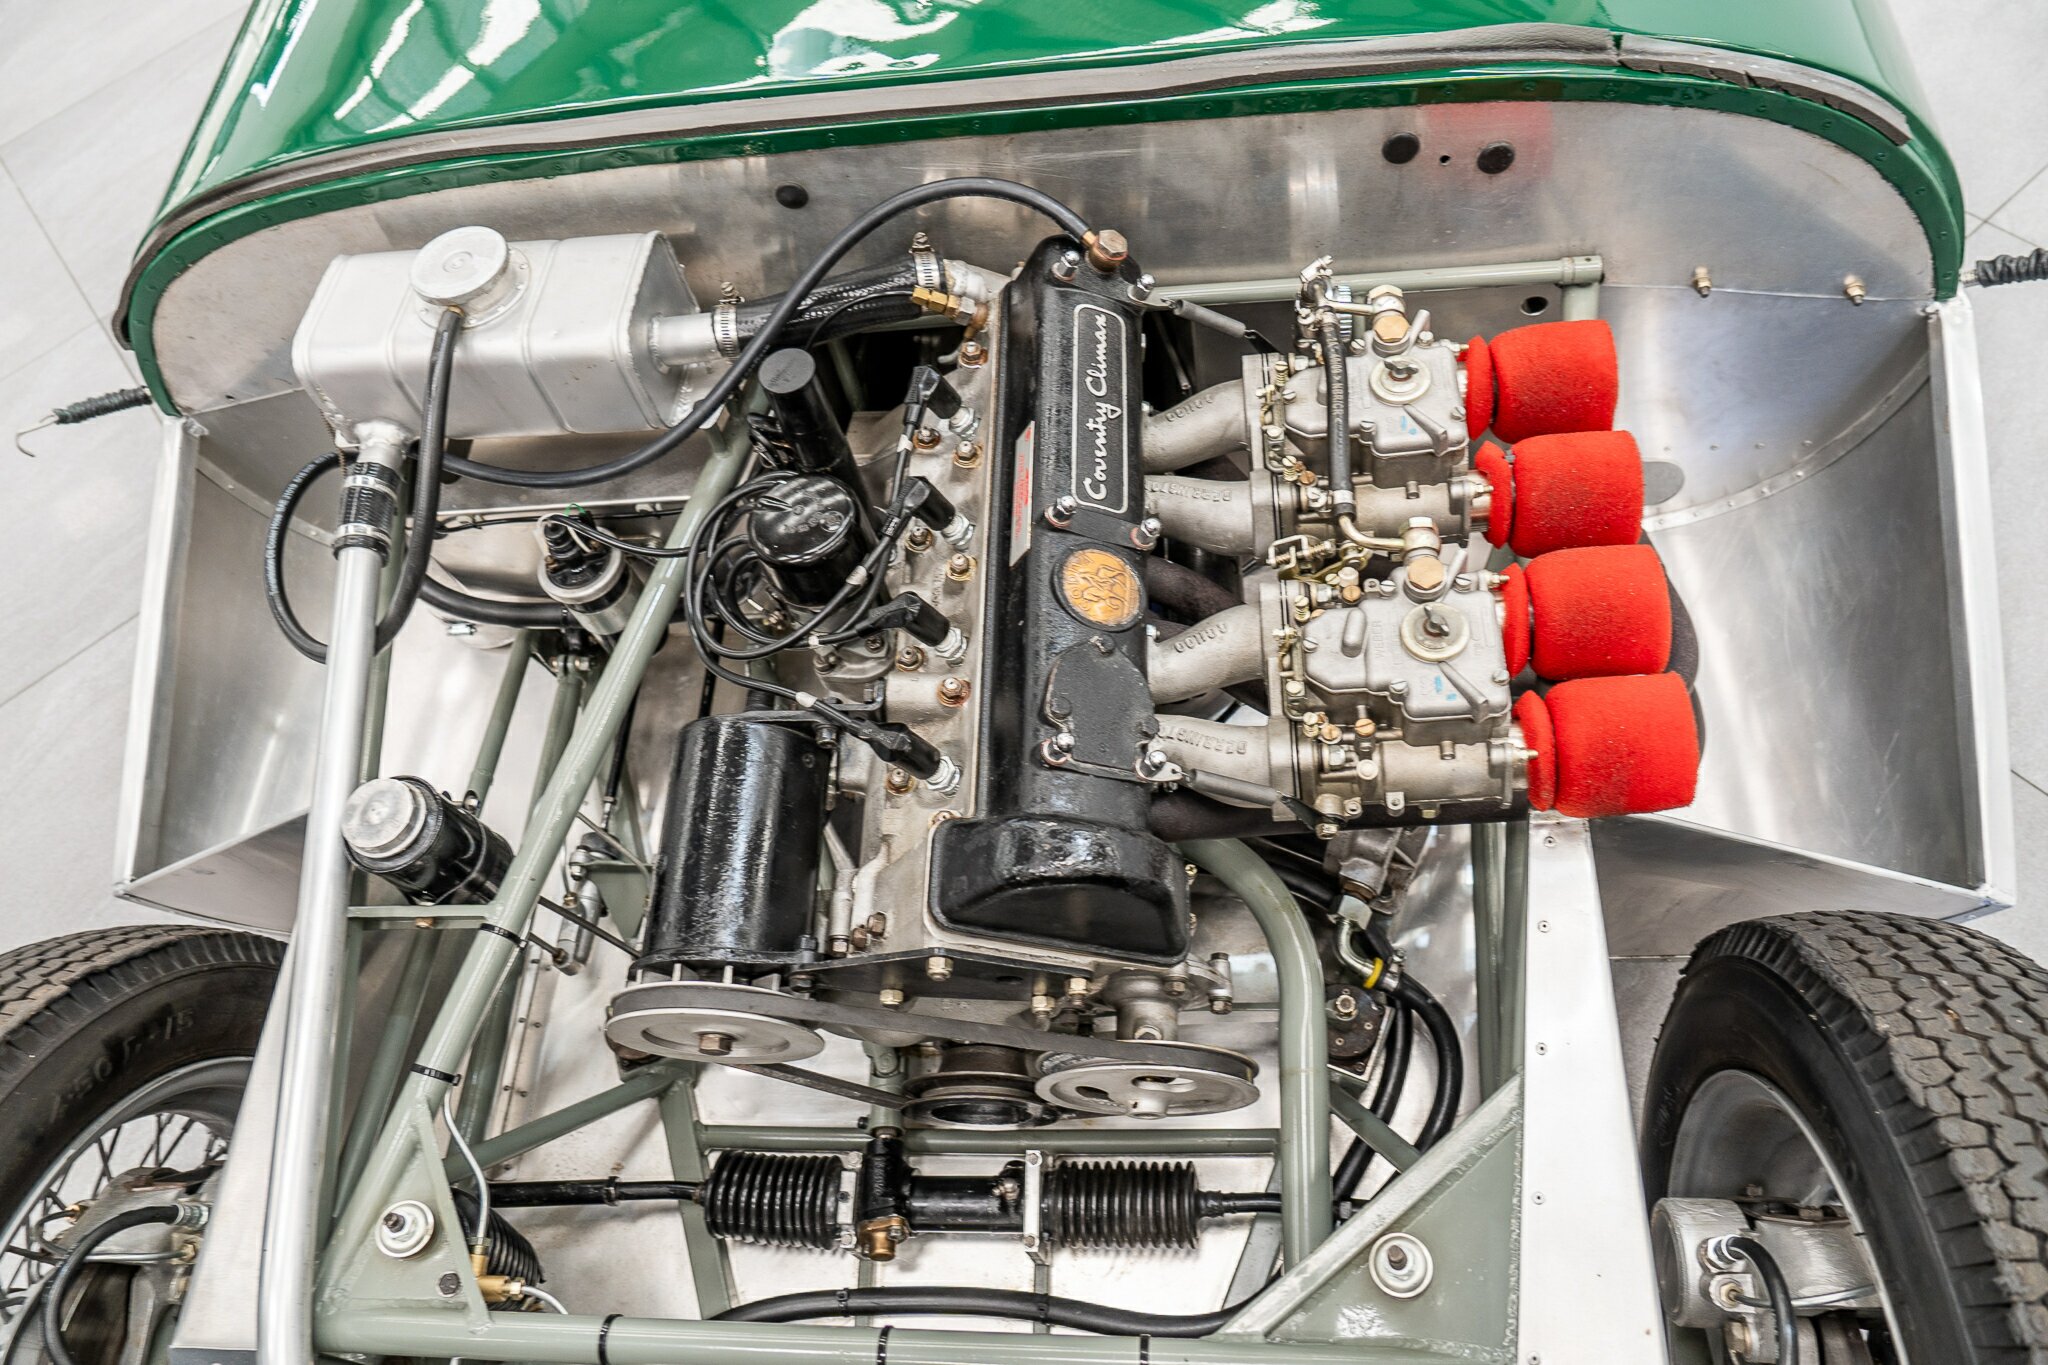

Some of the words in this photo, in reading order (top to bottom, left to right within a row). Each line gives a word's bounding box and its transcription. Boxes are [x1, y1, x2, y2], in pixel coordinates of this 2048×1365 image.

[1084, 313, 1108, 397] Climax
[1082, 402, 1122, 500] Coventry
[1063, 552, 1094, 611] GODIVA
